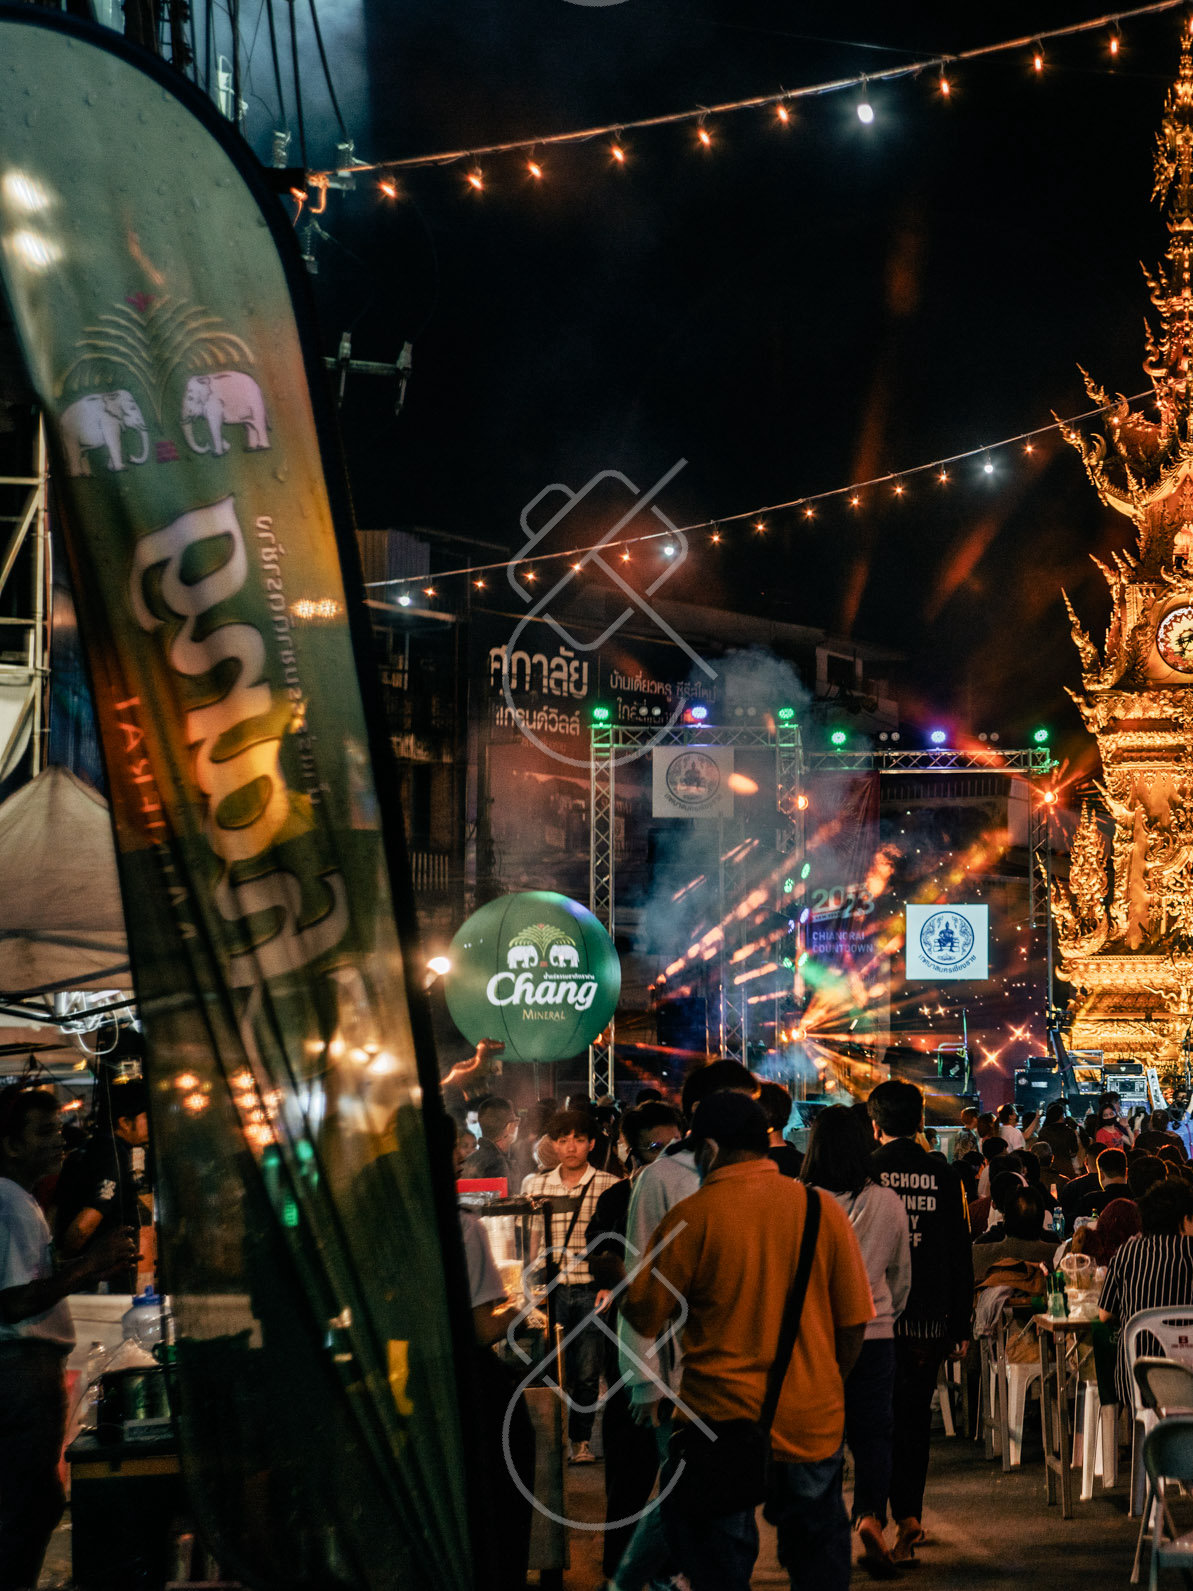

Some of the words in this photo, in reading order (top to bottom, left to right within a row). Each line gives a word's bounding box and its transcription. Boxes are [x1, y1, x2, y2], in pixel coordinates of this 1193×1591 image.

[811, 885, 876, 920] 2023
[812, 943, 874, 954] COUNTDOWN
[486, 971, 599, 1012] Chang
[522, 1008, 568, 1022] MINERAL
[880, 1171, 939, 1191] SCHOOL
[899, 1194, 937, 1212] NED
